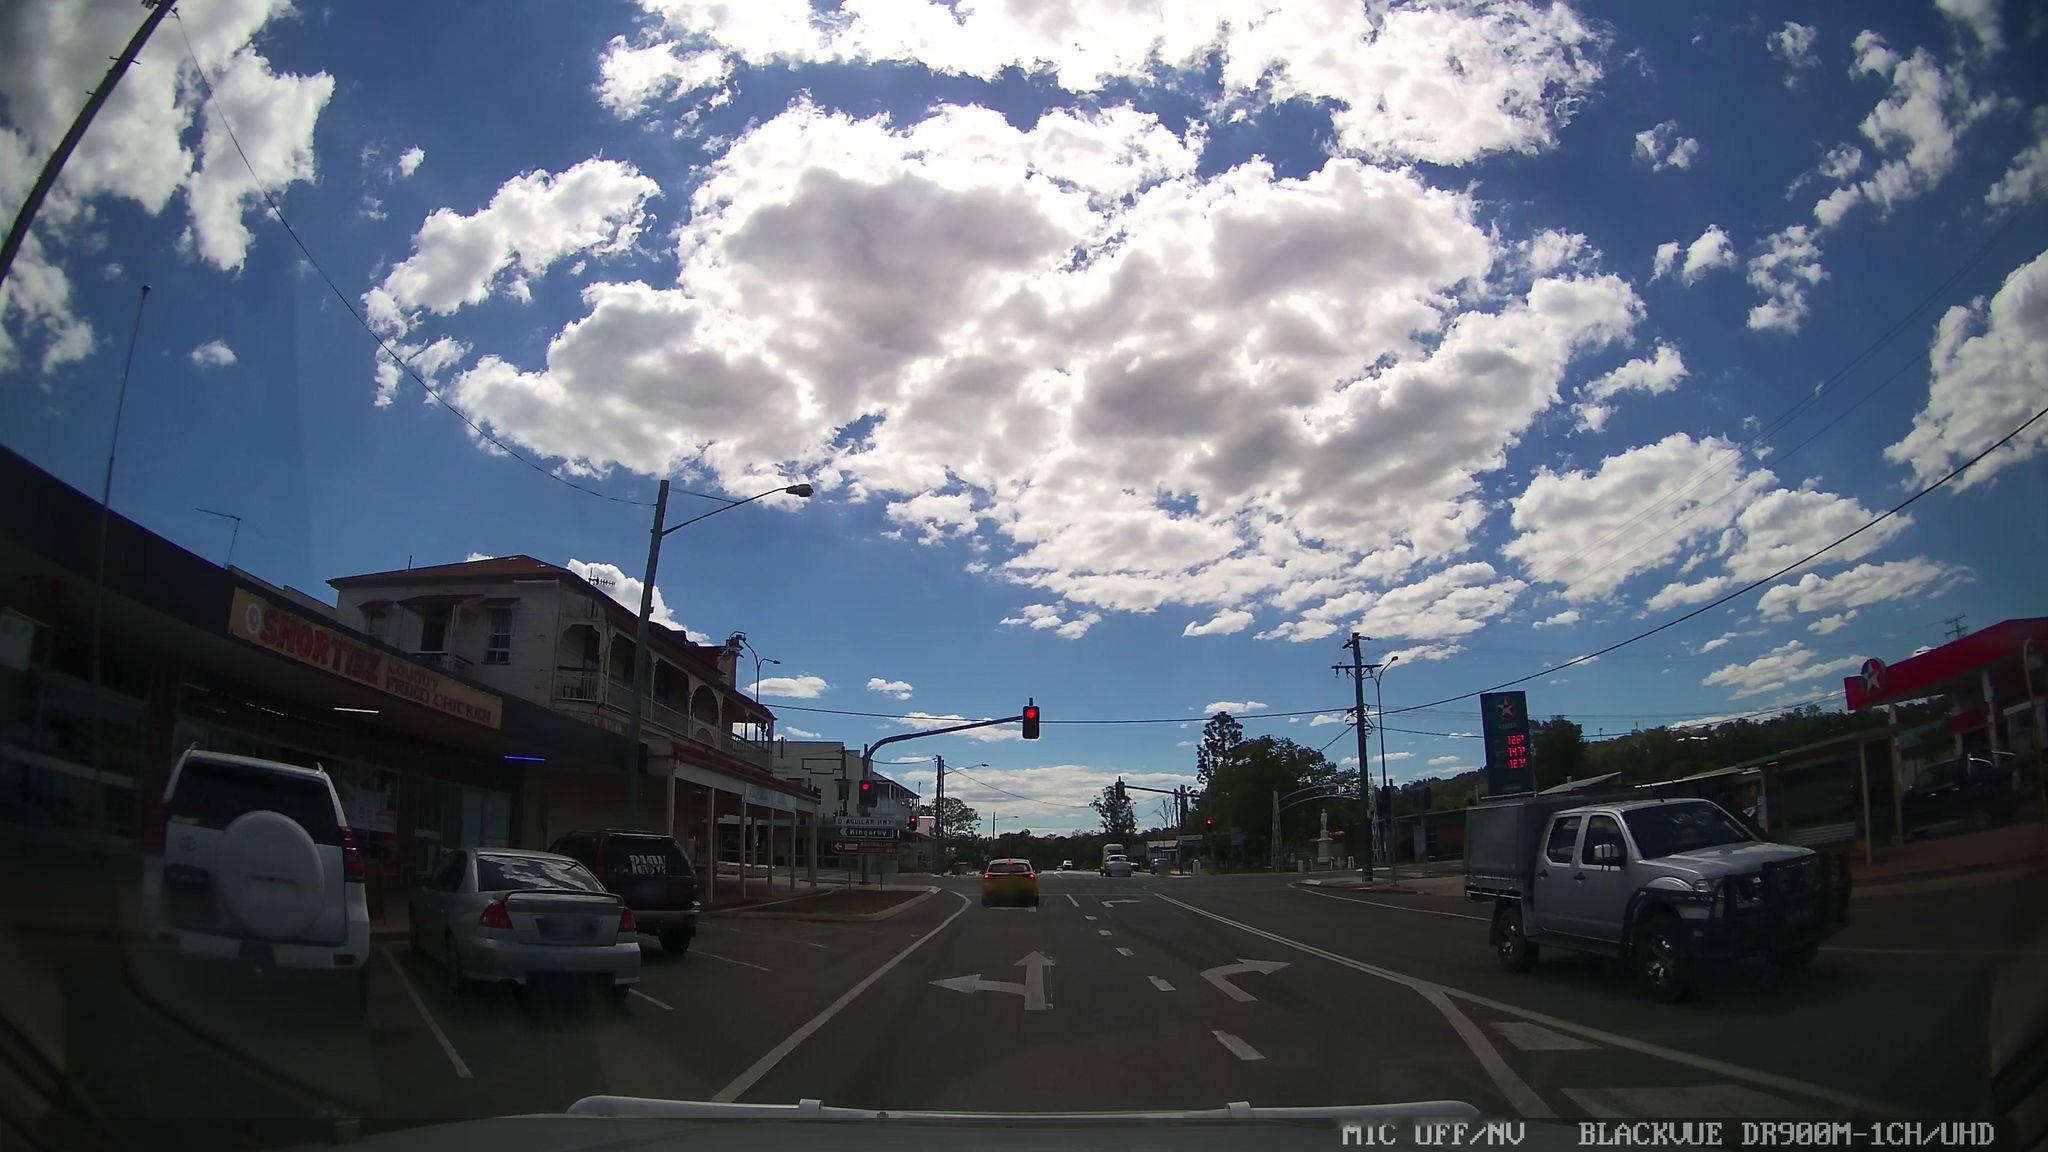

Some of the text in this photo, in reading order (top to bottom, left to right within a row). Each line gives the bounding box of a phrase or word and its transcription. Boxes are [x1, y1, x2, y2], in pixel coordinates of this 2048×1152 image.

[386, 675, 491, 722] FRIED CHICKEN
[849, 829, 886, 837] Kingaroy
